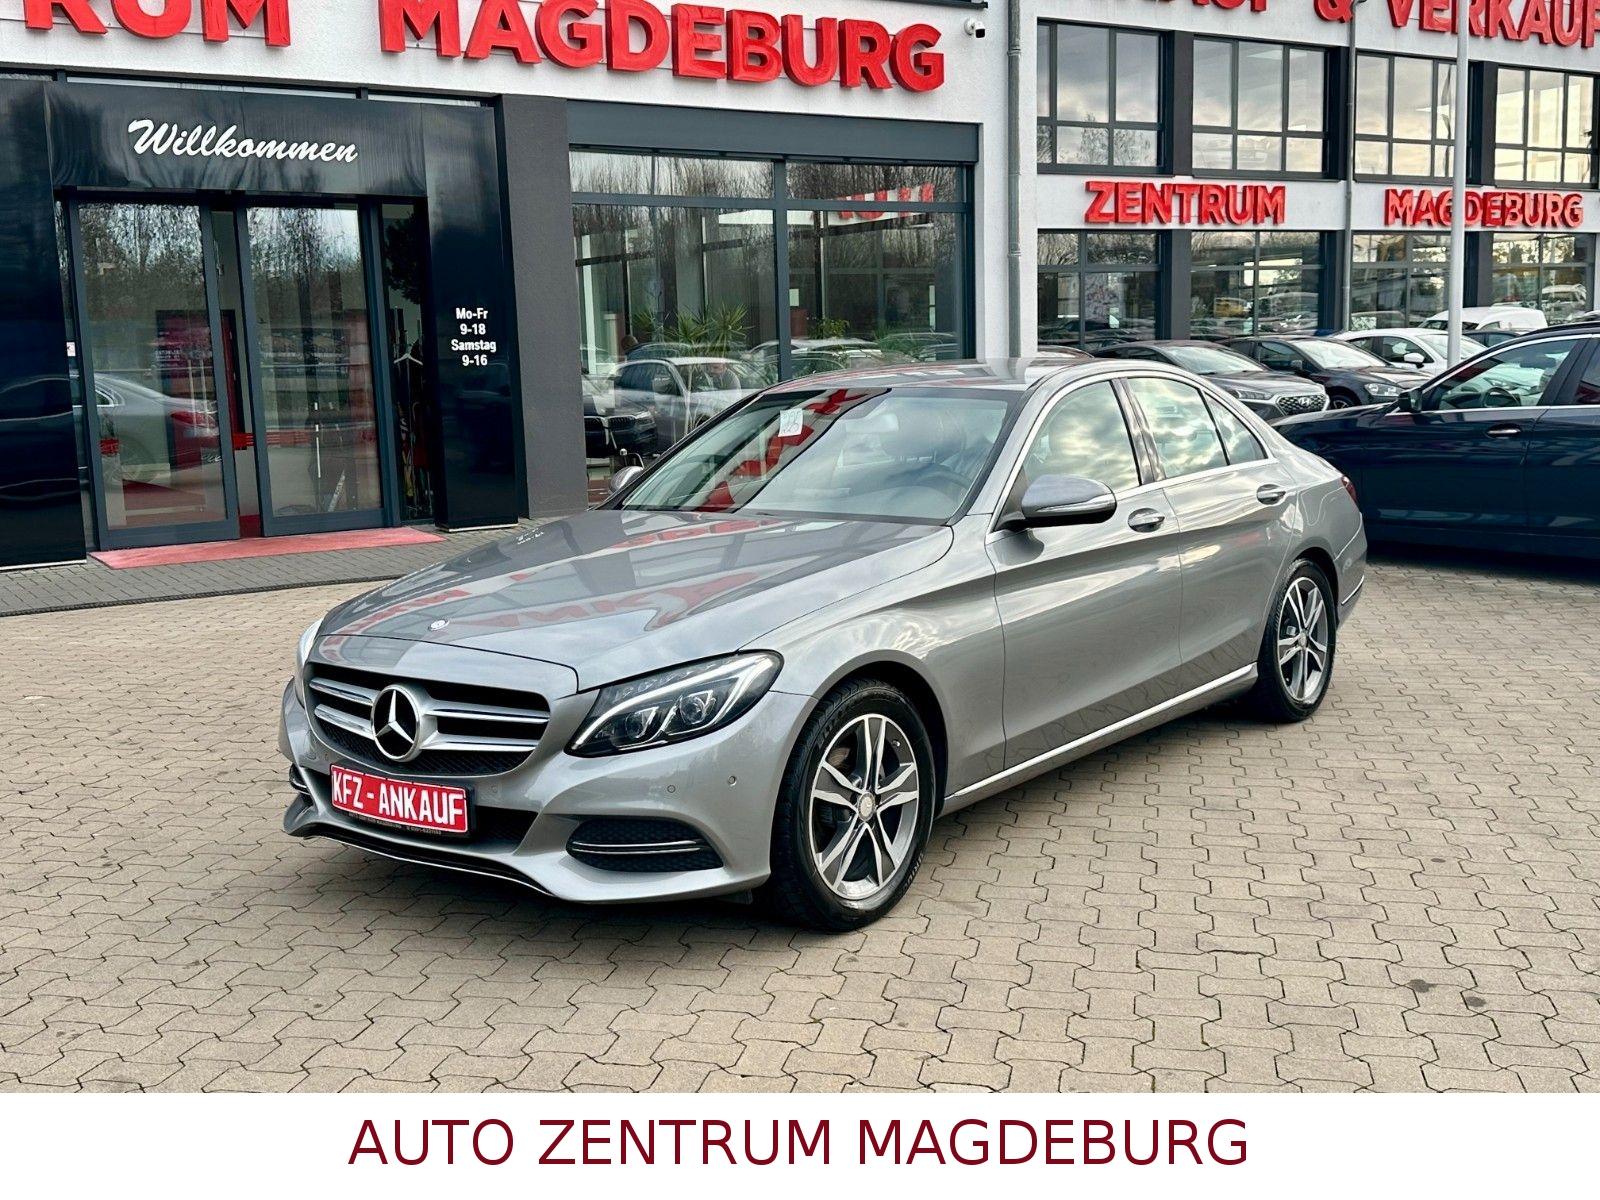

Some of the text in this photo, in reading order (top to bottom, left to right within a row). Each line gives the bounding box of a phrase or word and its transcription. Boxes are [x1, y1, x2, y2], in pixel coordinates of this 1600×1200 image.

[379, 0, 946, 93] MAGDEBURG
[128, 120, 359, 163] Willkommen
[1084, 180, 1584, 227] ZENTRUM MAGDEBURG
[455, 307, 488, 320] Mo-Fr
[459, 323, 486, 335] 9-18
[450, 338, 497, 353] Samstag
[461, 354, 488, 367] 9-16
